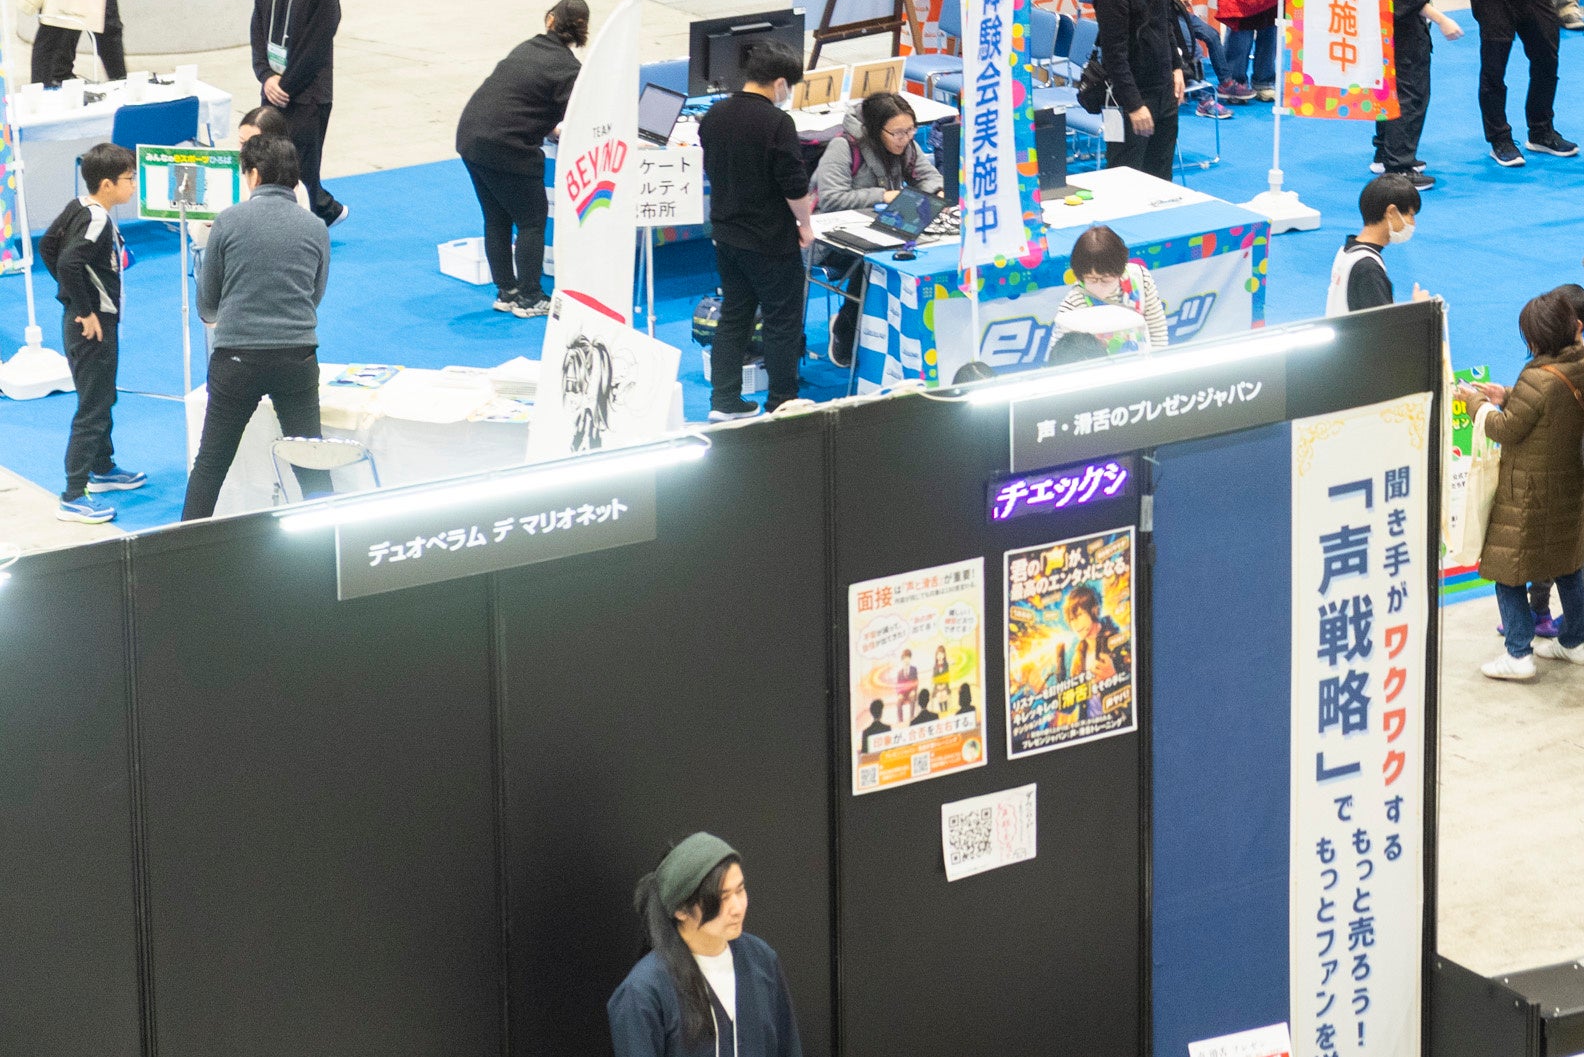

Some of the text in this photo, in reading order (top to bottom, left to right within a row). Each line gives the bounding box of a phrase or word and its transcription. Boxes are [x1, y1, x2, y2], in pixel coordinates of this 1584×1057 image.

[640, 157, 690, 174] ケート
[640, 181, 690, 196] ルティ
[636, 201, 676, 219] 布所
[1036, 381, 1262, 443] 声・滑舌のプレゼンジャパン
[368, 498, 628, 567] デュオベラム デ マリオネット
[1316, 477, 1374, 822] 「声戦略」で
[1383, 465, 1411, 861] 聞き手がワクワクする
[1316, 837, 1339, 1057] もっとファンを
[1348, 828, 1376, 1047] もっと売ろう!
